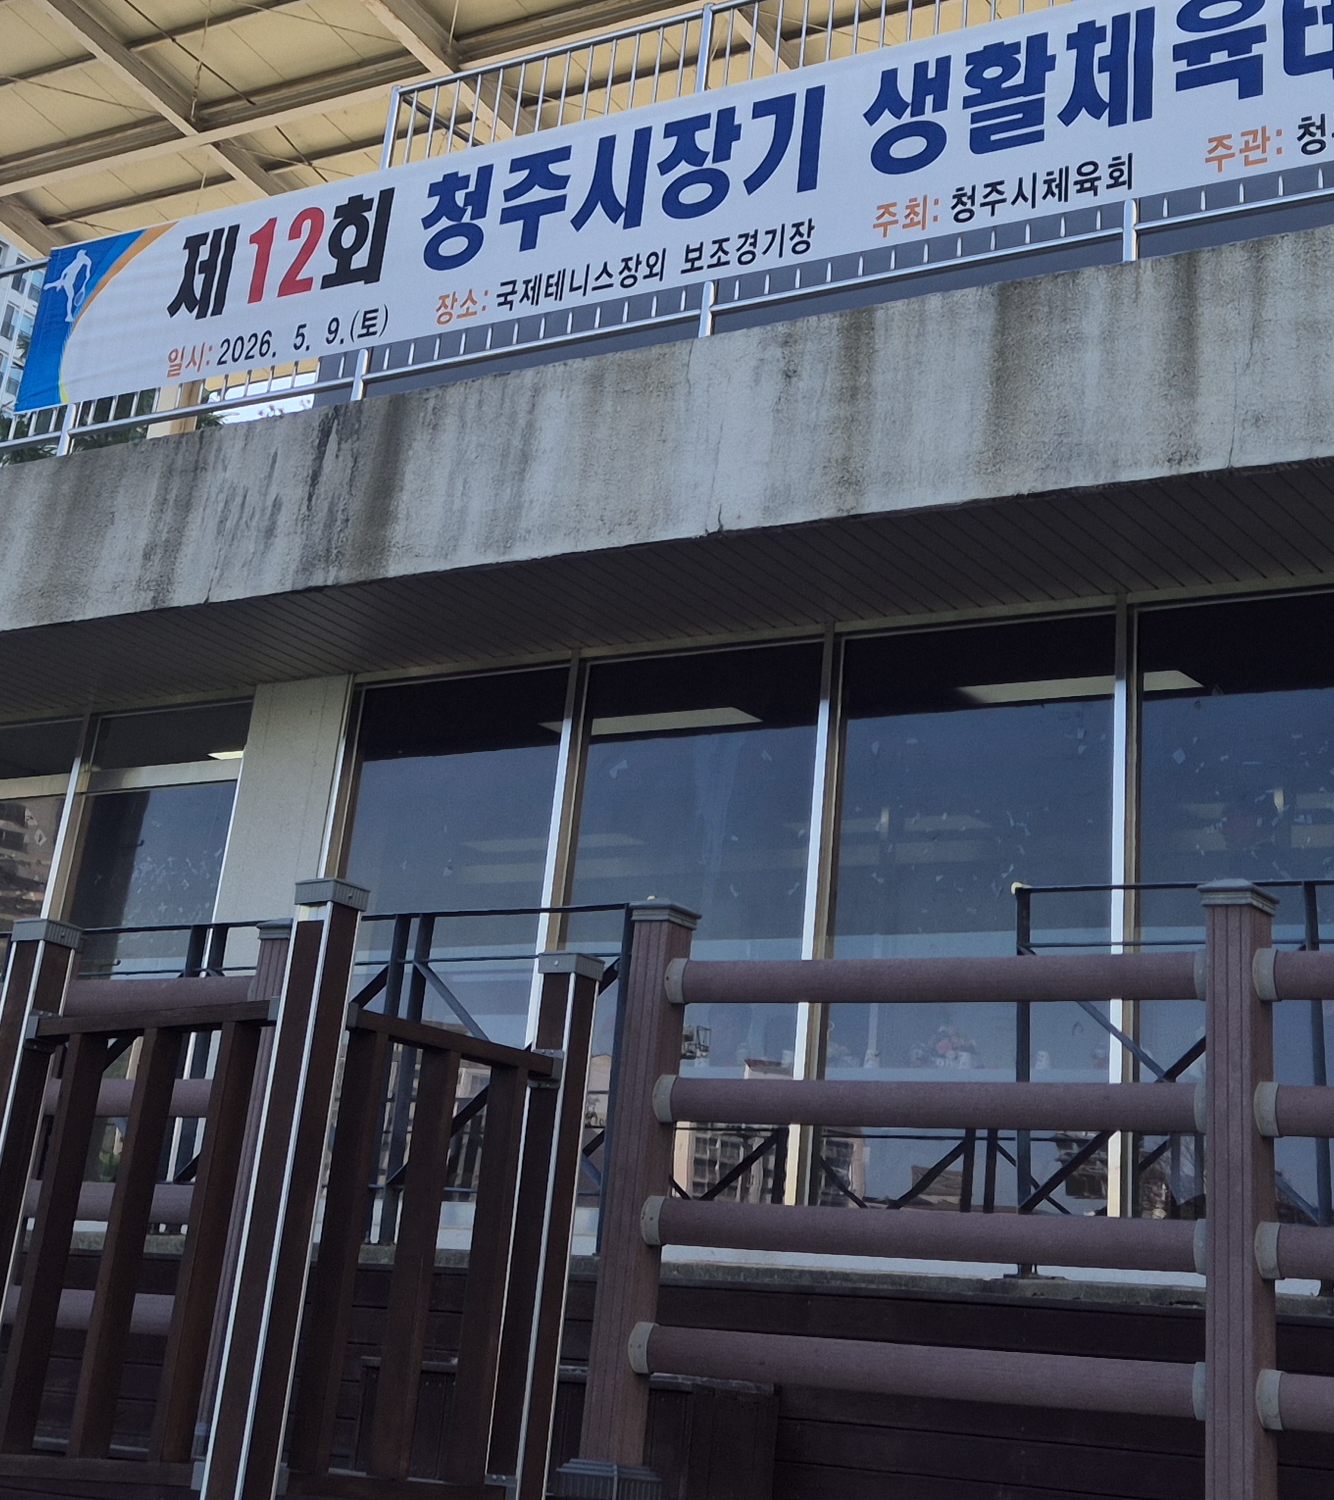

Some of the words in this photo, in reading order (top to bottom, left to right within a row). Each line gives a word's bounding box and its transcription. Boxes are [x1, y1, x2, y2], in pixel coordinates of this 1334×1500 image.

[167, 186, 397, 320] 제12회
[419, 84, 827, 272] 청주시장기
[167, 342, 213, 378] 일시:
[216, 329, 277, 366] 2026.
[292, 324, 312, 353] 5.
[434, 286, 489, 327] 장소:
[494, 243, 668, 311] 국제테니스장외
[681, 217, 817, 277] 보조경기장
[872, 192, 940, 235] 주최:
[949, 151, 1136, 224] 청주시체육회
[1203, 124, 1285, 174] 주관:
